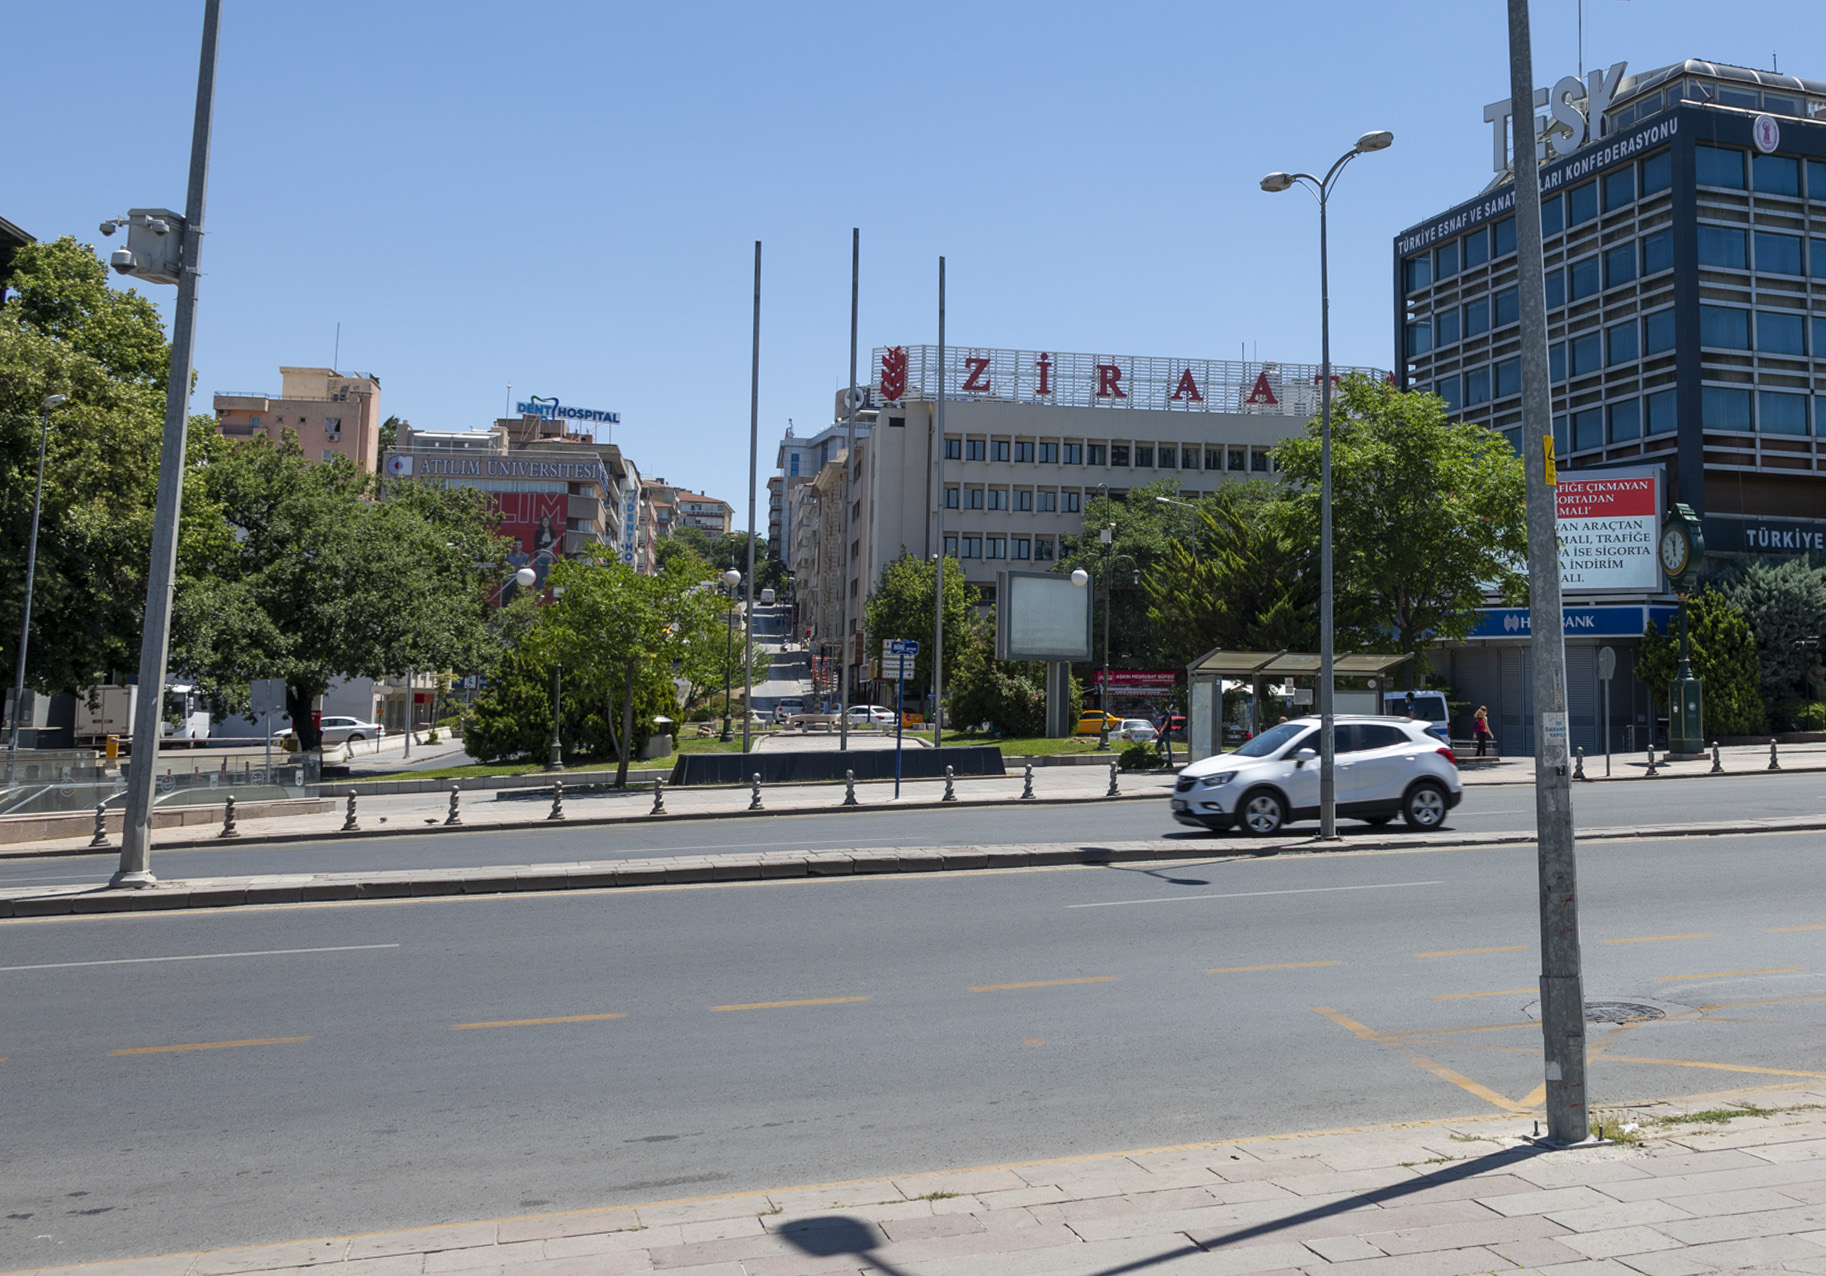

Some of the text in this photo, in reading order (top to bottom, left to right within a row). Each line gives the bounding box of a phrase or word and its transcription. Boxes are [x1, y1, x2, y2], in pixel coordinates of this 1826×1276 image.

[1398, 226, 1436, 254] TÜRKİYE
[1437, 213, 1468, 238] ESNAF
[1470, 206, 1483, 223] VE
[1565, 117, 1679, 181] KONFEDERASYONU
[517, 402, 620, 424] DENT HOSPITAL
[420, 456, 597, 479] ATILIM ÜNİVERSİTESİ
[1586, 481, 1649, 494] ÇIKMAYAN
[624, 503, 635, 565] DENTHO
[1582, 520, 1643, 533] ARAÇTAN
[1595, 531, 1651, 543] TRAFİĞE
[1746, 526, 1824, 549] TÜRKİYE
[1574, 546, 1593, 557] İSE
[1595, 544, 1651, 556] SİGORTA
[1570, 557, 1624, 570] İNDİRİM
